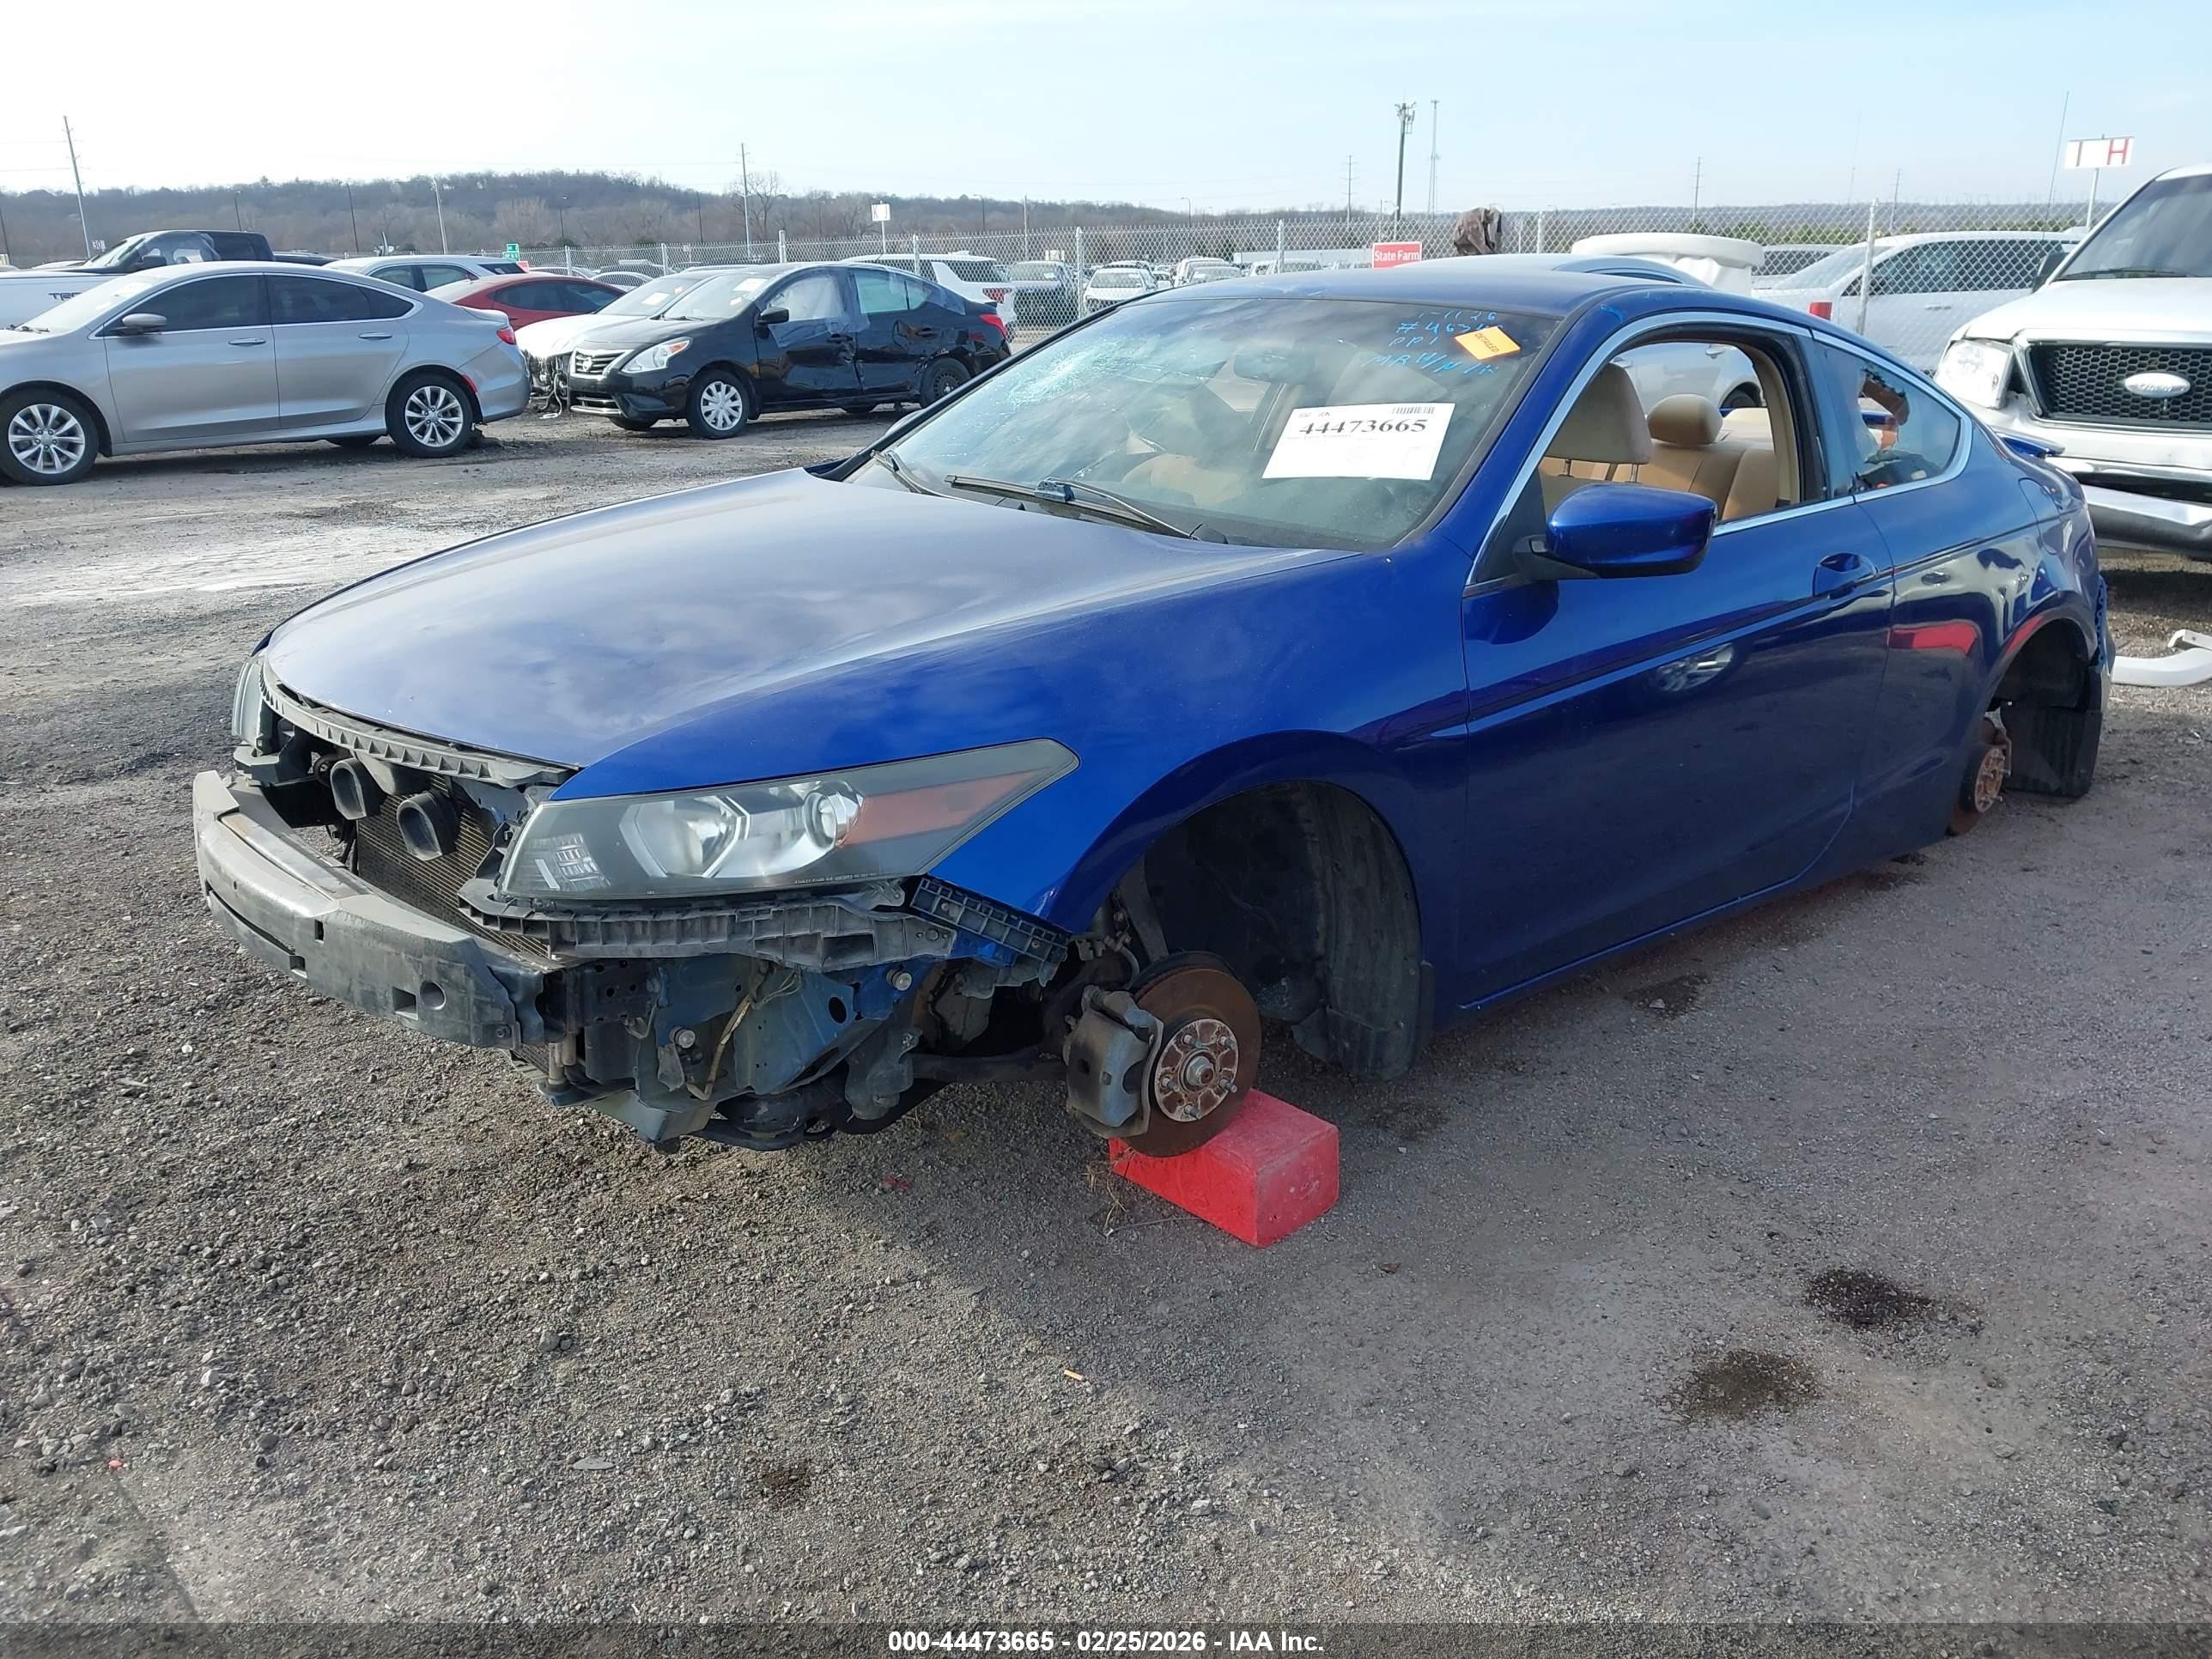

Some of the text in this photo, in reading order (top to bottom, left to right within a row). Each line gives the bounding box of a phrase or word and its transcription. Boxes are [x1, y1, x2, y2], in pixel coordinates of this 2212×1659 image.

[2106, 137, 2130, 166] H
[1374, 250, 1419, 261] State Farm
[1298, 418, 1428, 434] 44473665
